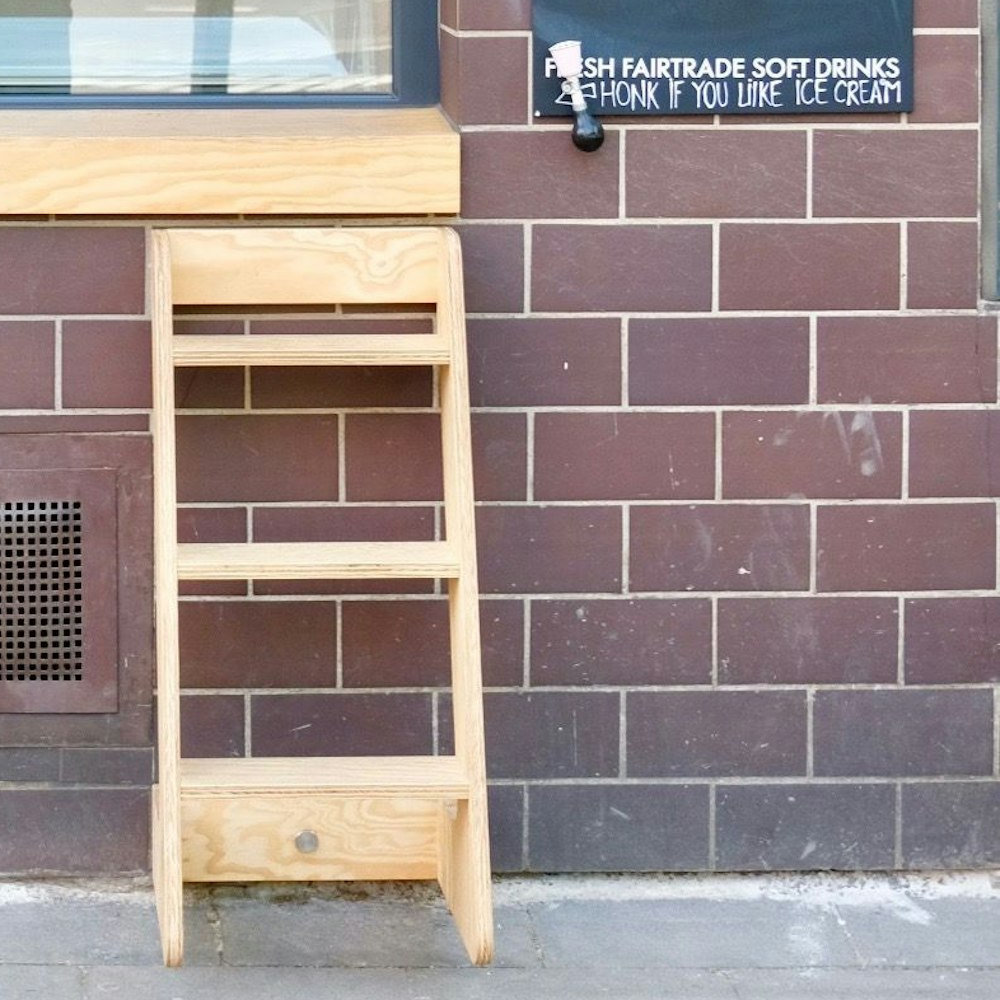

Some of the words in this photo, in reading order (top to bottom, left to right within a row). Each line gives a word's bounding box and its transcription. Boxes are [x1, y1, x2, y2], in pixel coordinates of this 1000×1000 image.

[544, 57, 615, 79] FSH
[622, 57, 745, 79] FAIRTRADE
[751, 57, 811, 79] SOFT
[815, 57, 900, 79] DRINKS
[600, 80, 660, 110] HONK
[669, 77, 685, 110] IF
[691, 80, 729, 109] YOU
[795, 77, 828, 106] ICE
[834, 77, 902, 106] CREAM
